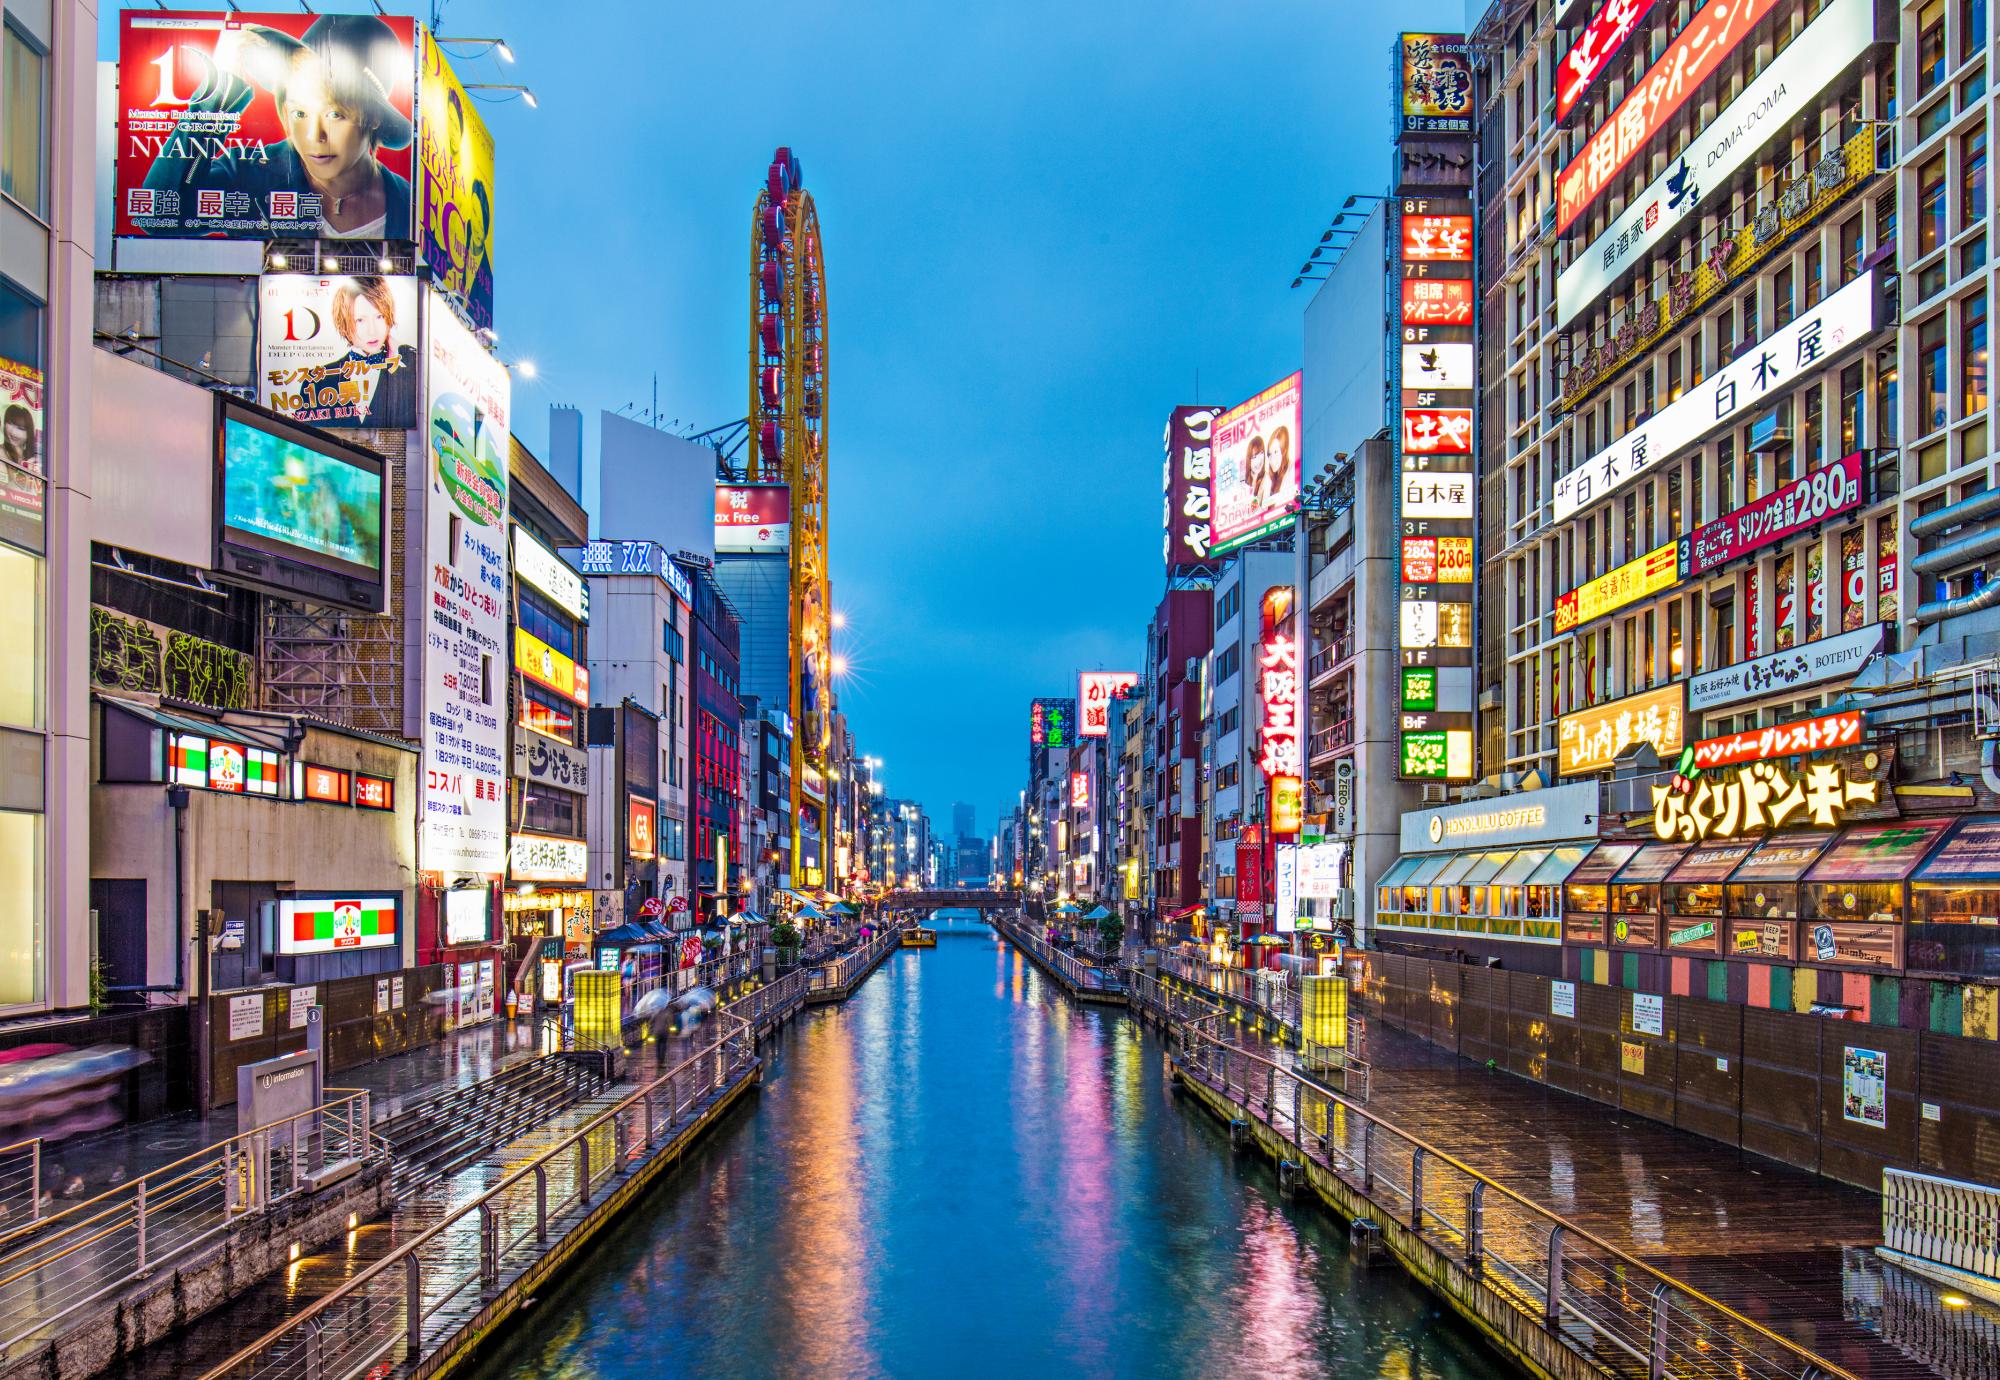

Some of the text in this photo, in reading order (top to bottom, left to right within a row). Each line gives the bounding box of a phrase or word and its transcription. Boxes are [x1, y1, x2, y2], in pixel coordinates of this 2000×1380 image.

[128, 109, 241, 121] Monster Entertainment
[1407, 115, 1469, 131] 9F 全室個室
[1707, 83, 1787, 168] DOMA-DOMA
[128, 121, 241, 134] DEEP GROUP
[129, 135, 270, 161] NYANNYA
[128, 189, 180, 217] 最強
[198, 190, 250, 217] 最幸
[270, 191, 323, 219] 最高
[1603, 217, 1645, 271] 居酒家
[1414, 283, 1443, 300] 相席
[1404, 300, 1472, 321] ダイニング
[268, 356, 403, 386] モンスターグループ
[1715, 317, 1826, 420] 白木屋
[271, 380, 370, 411] No.1の男!
[1418, 393, 1436, 406] 5F
[334, 407, 372, 418] RUKA
[1219, 414, 1261, 452] 高収入
[1406, 414, 1470, 450] はや
[1557, 433, 1649, 506] 4F 白木屋
[1407, 480, 1467, 504] 白木屋
[1738, 463, 1858, 547] ドリンク全品280円
[733, 512, 759, 523] Free
[1442, 539, 1468, 548] 全品
[1439, 549, 1471, 569] 280円
[1815, 646, 1862, 668] BOTEJYU
[1693, 673, 1740, 697] 大阪 お好み焼
[1261, 634, 1296, 776] 大阪王将
[1403, 715, 1427, 729] B1F
[1562, 720, 1578, 740] 2F
[1407, 741, 1443, 760] びっくり
[1695, 717, 1858, 762] ハンバーグレストラン
[529, 739, 571, 784] うなぎ
[1405, 757, 1446, 774] ドンキー
[317, 774, 330, 795] 酒
[356, 781, 383, 803] たばこ
[428, 770, 502, 802] コスパ 最高!
[1338, 779, 1347, 806] ZERO
[1652, 762, 1877, 841] びっくりドンキー
[635, 814, 647, 840] G3
[1446, 808, 1544, 834] HONOLULU COFFEE
[1766, 925, 1779, 934] KEEP
[1838, 945, 1882, 965] hamburg
[273, 1068, 304, 1083] information
